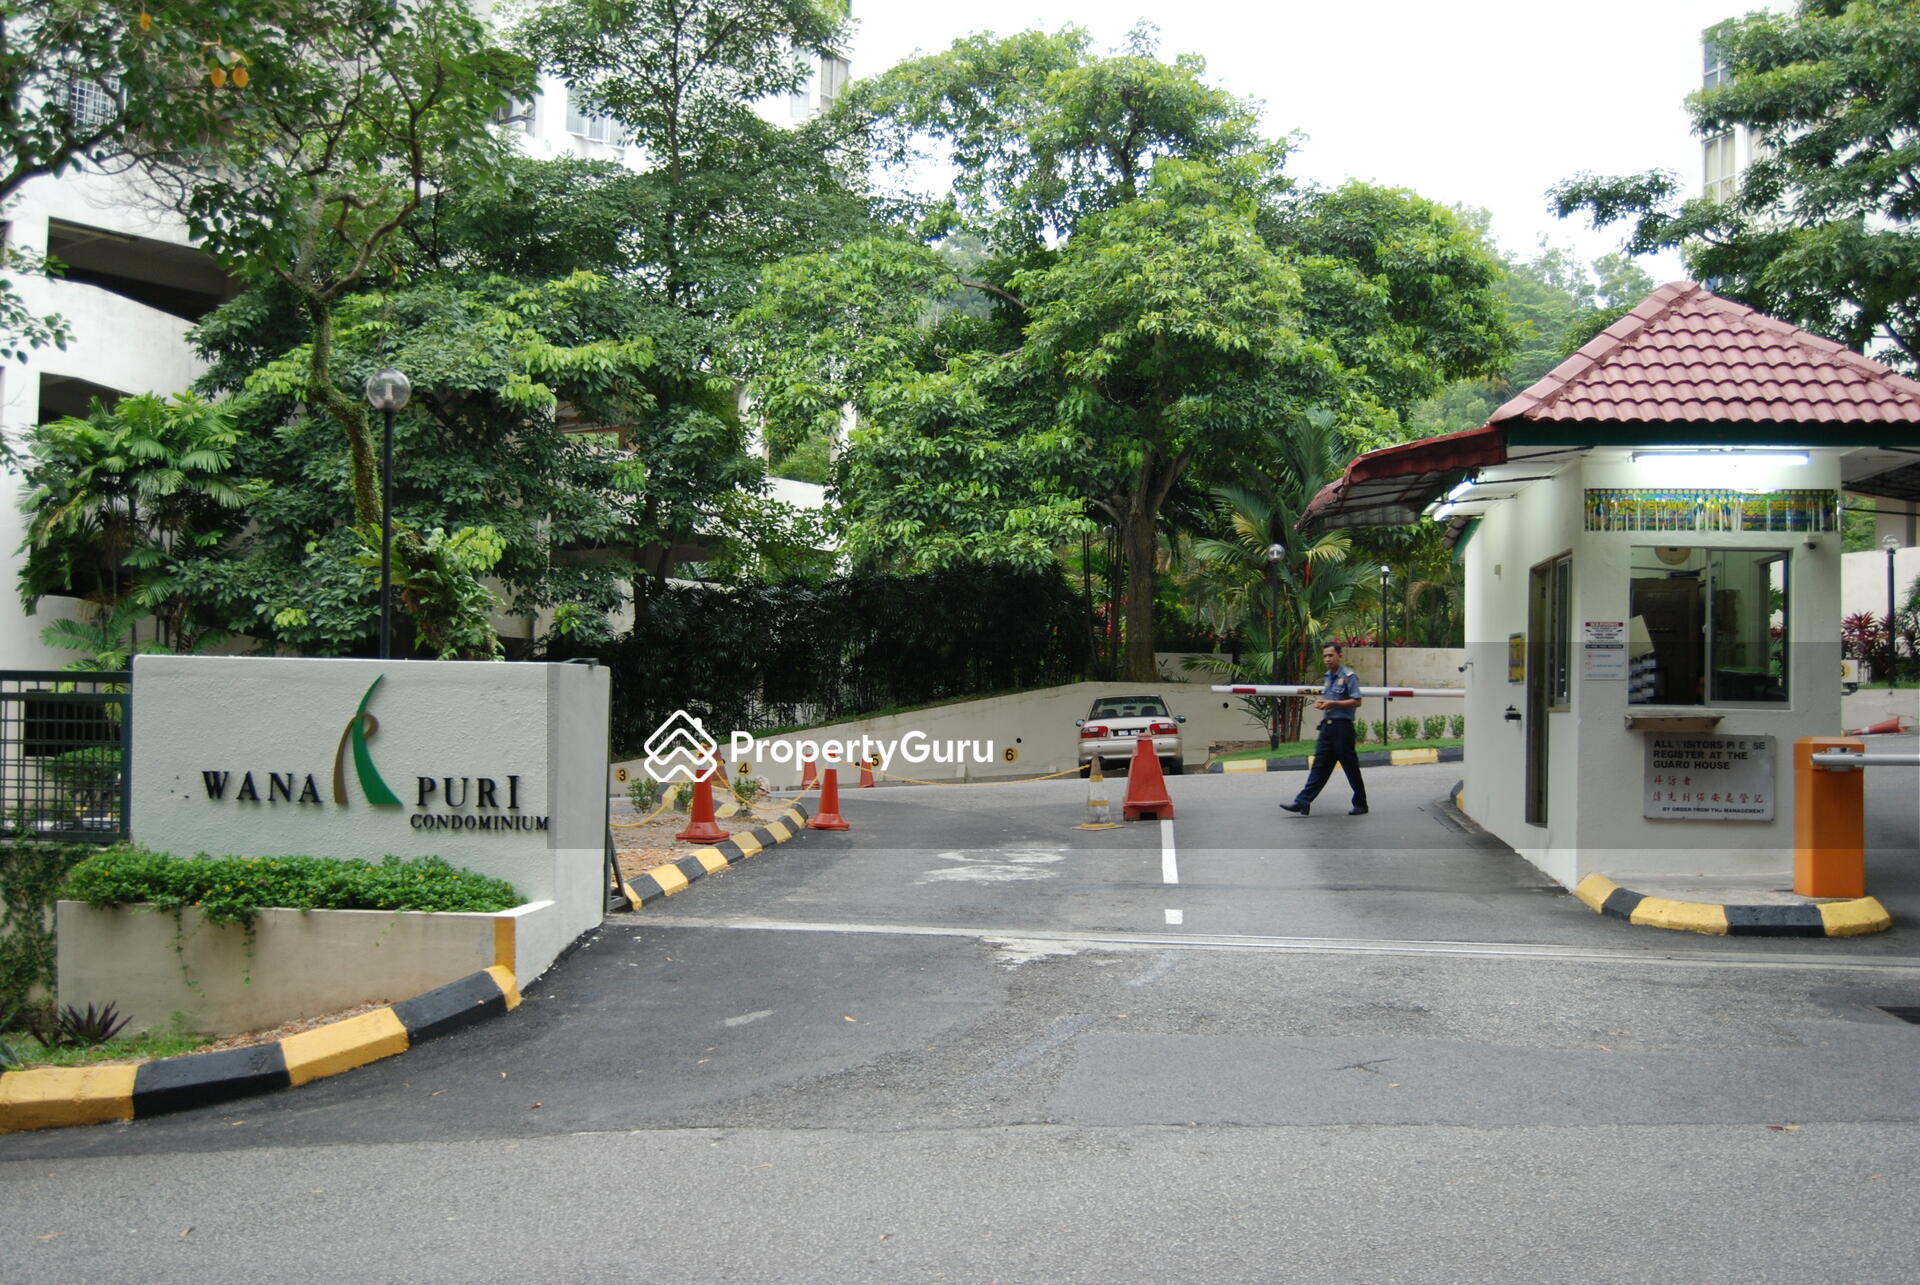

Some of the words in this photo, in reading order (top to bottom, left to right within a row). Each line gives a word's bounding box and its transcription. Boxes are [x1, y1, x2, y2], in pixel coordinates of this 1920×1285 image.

[1653, 740, 1674, 749] ALL
[1677, 740, 1725, 750] ISITORS
[871, 753, 879, 767] 5
[1006, 748, 1014, 761] 6
[1653, 750, 1705, 759] REGISTER
[1708, 751, 1723, 760] AT
[1728, 751, 1749, 760] THE
[738, 762, 748, 774] 4
[1653, 760, 1690, 769] GUARD
[1694, 761, 1731, 770] HOUSE
[618, 769, 627, 782] 3
[201, 770, 323, 803] WANA
[416, 774, 521, 809] PURI
[410, 813, 549, 831] CONDOMINIUM
